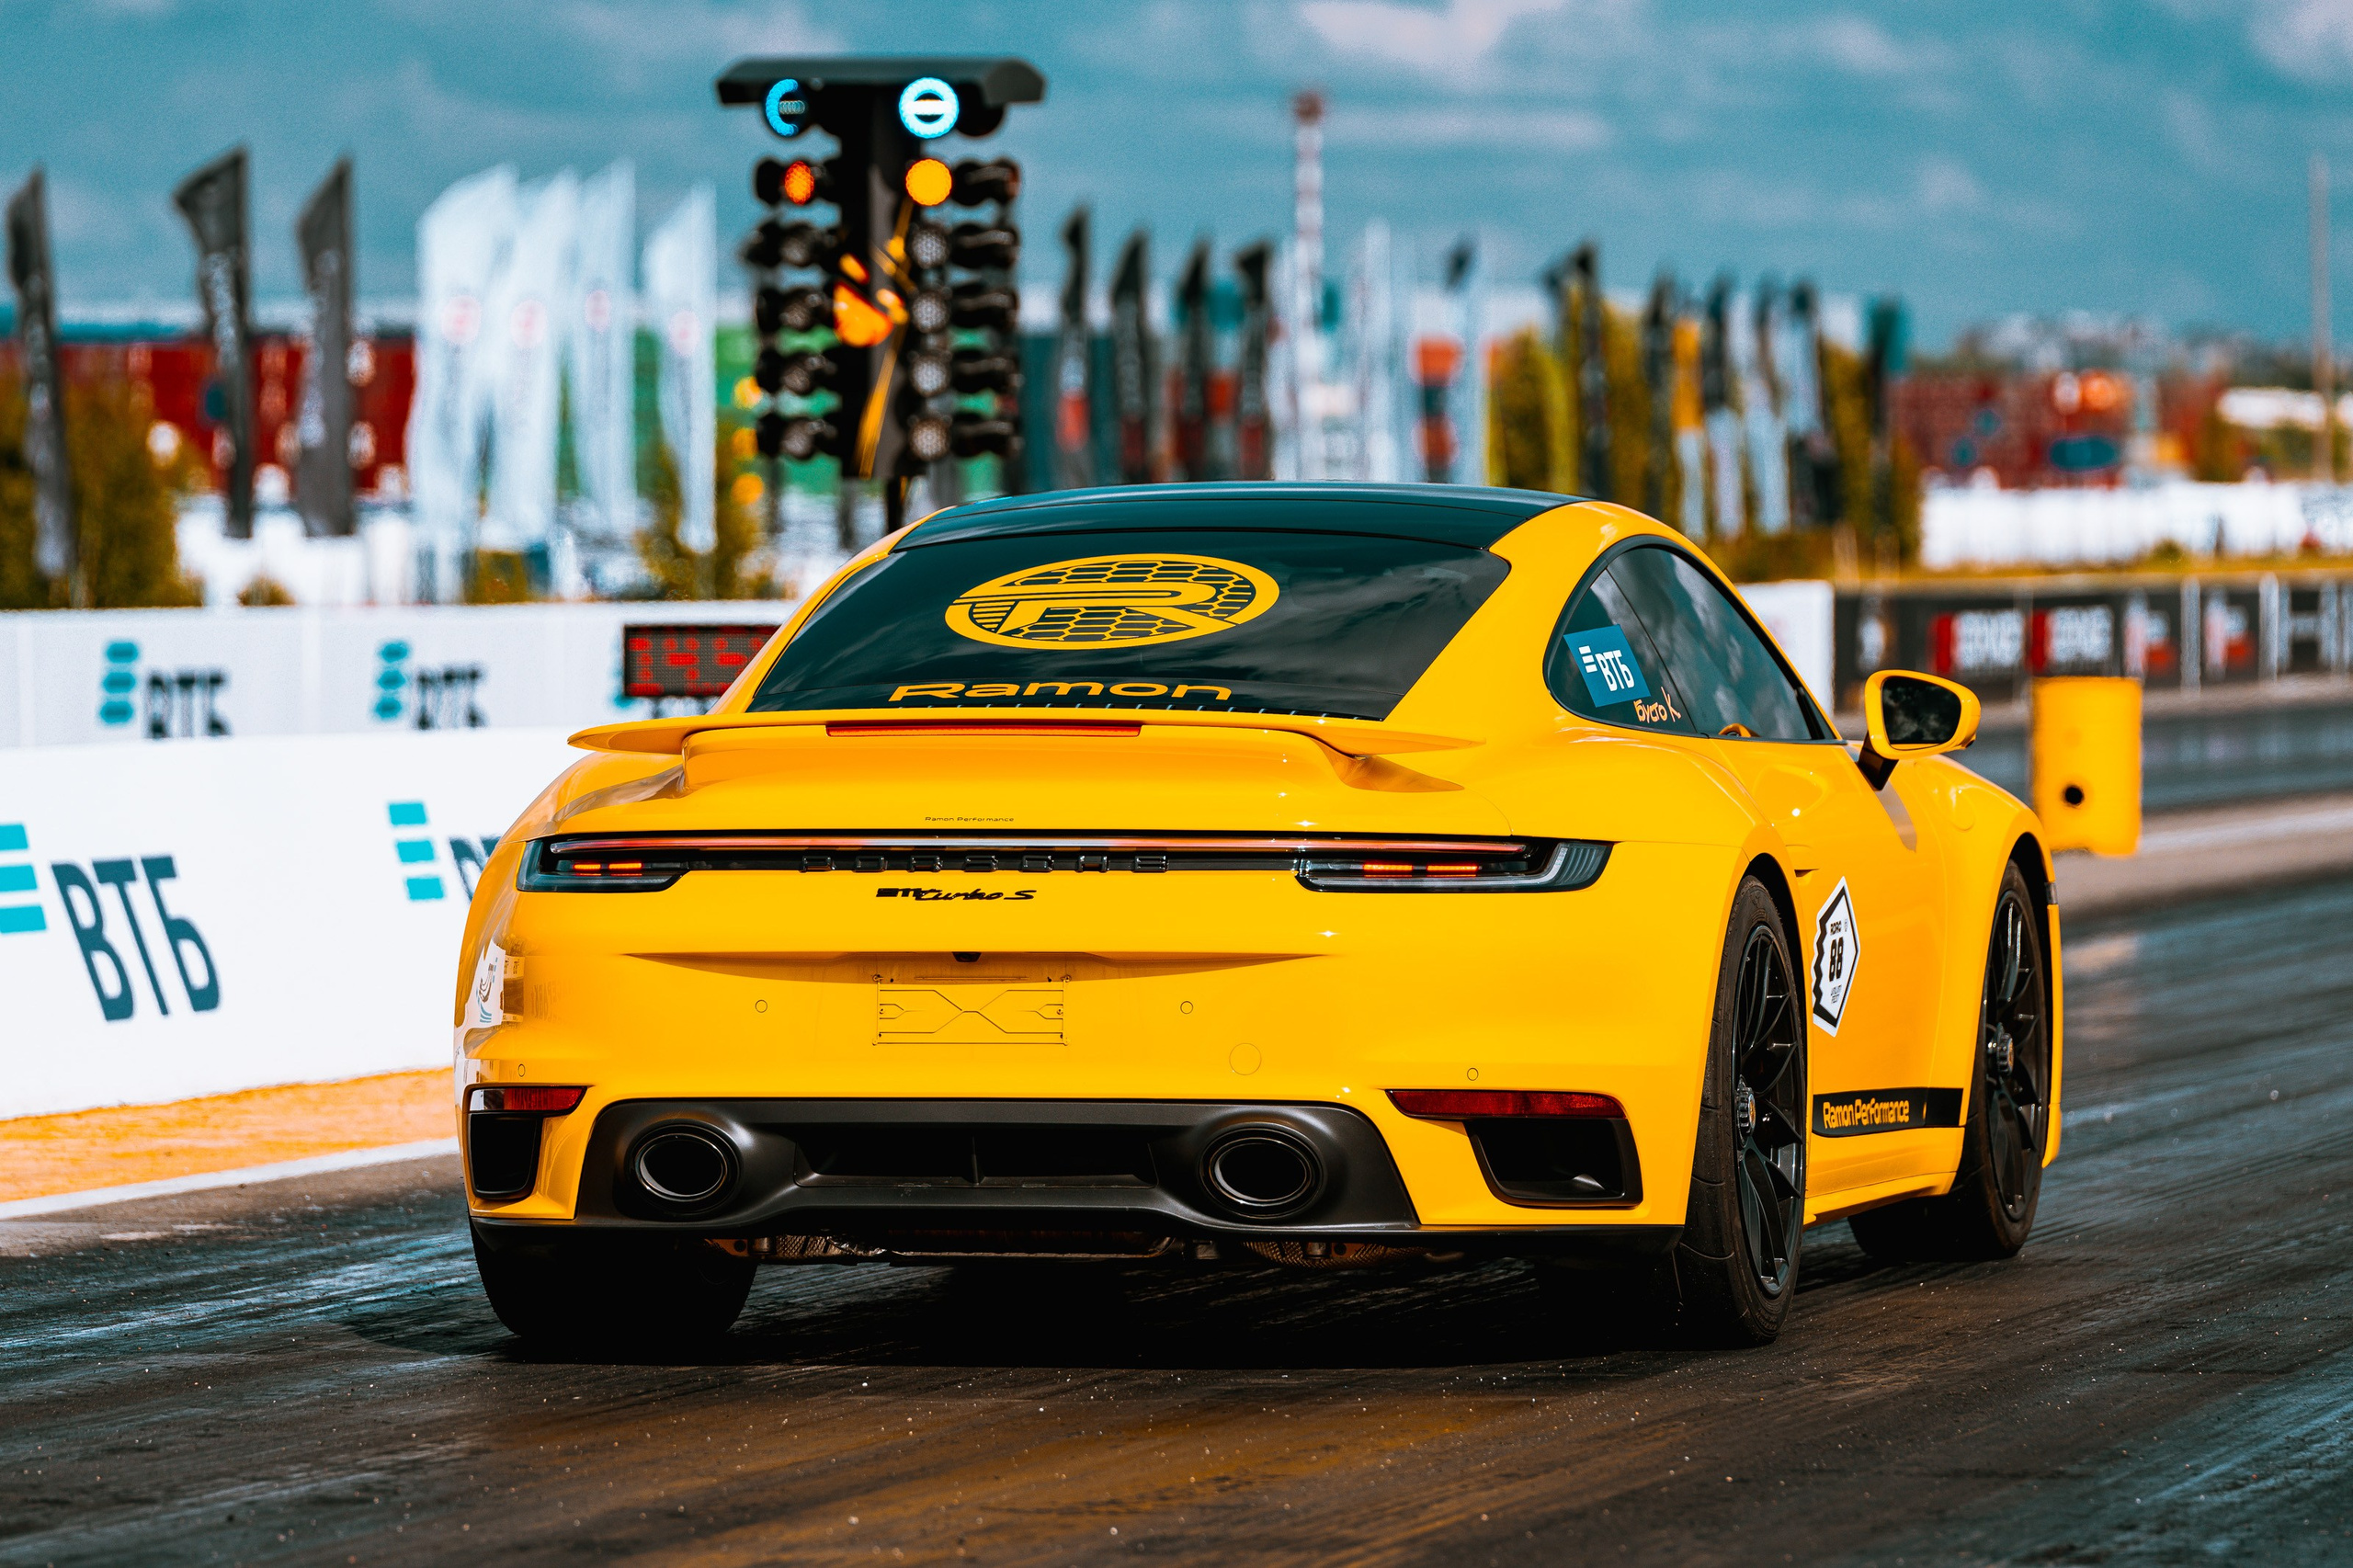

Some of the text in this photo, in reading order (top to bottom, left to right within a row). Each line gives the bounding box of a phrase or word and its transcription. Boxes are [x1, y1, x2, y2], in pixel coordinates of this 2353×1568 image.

[887, 682, 1233, 702] Ramon
[1595, 649, 1635, 692] ВТБ
[51, 854, 221, 1022] ВТБ
[1828, 937, 1844, 982] 88
[1823, 1097, 1910, 1130] Ramon Performance
